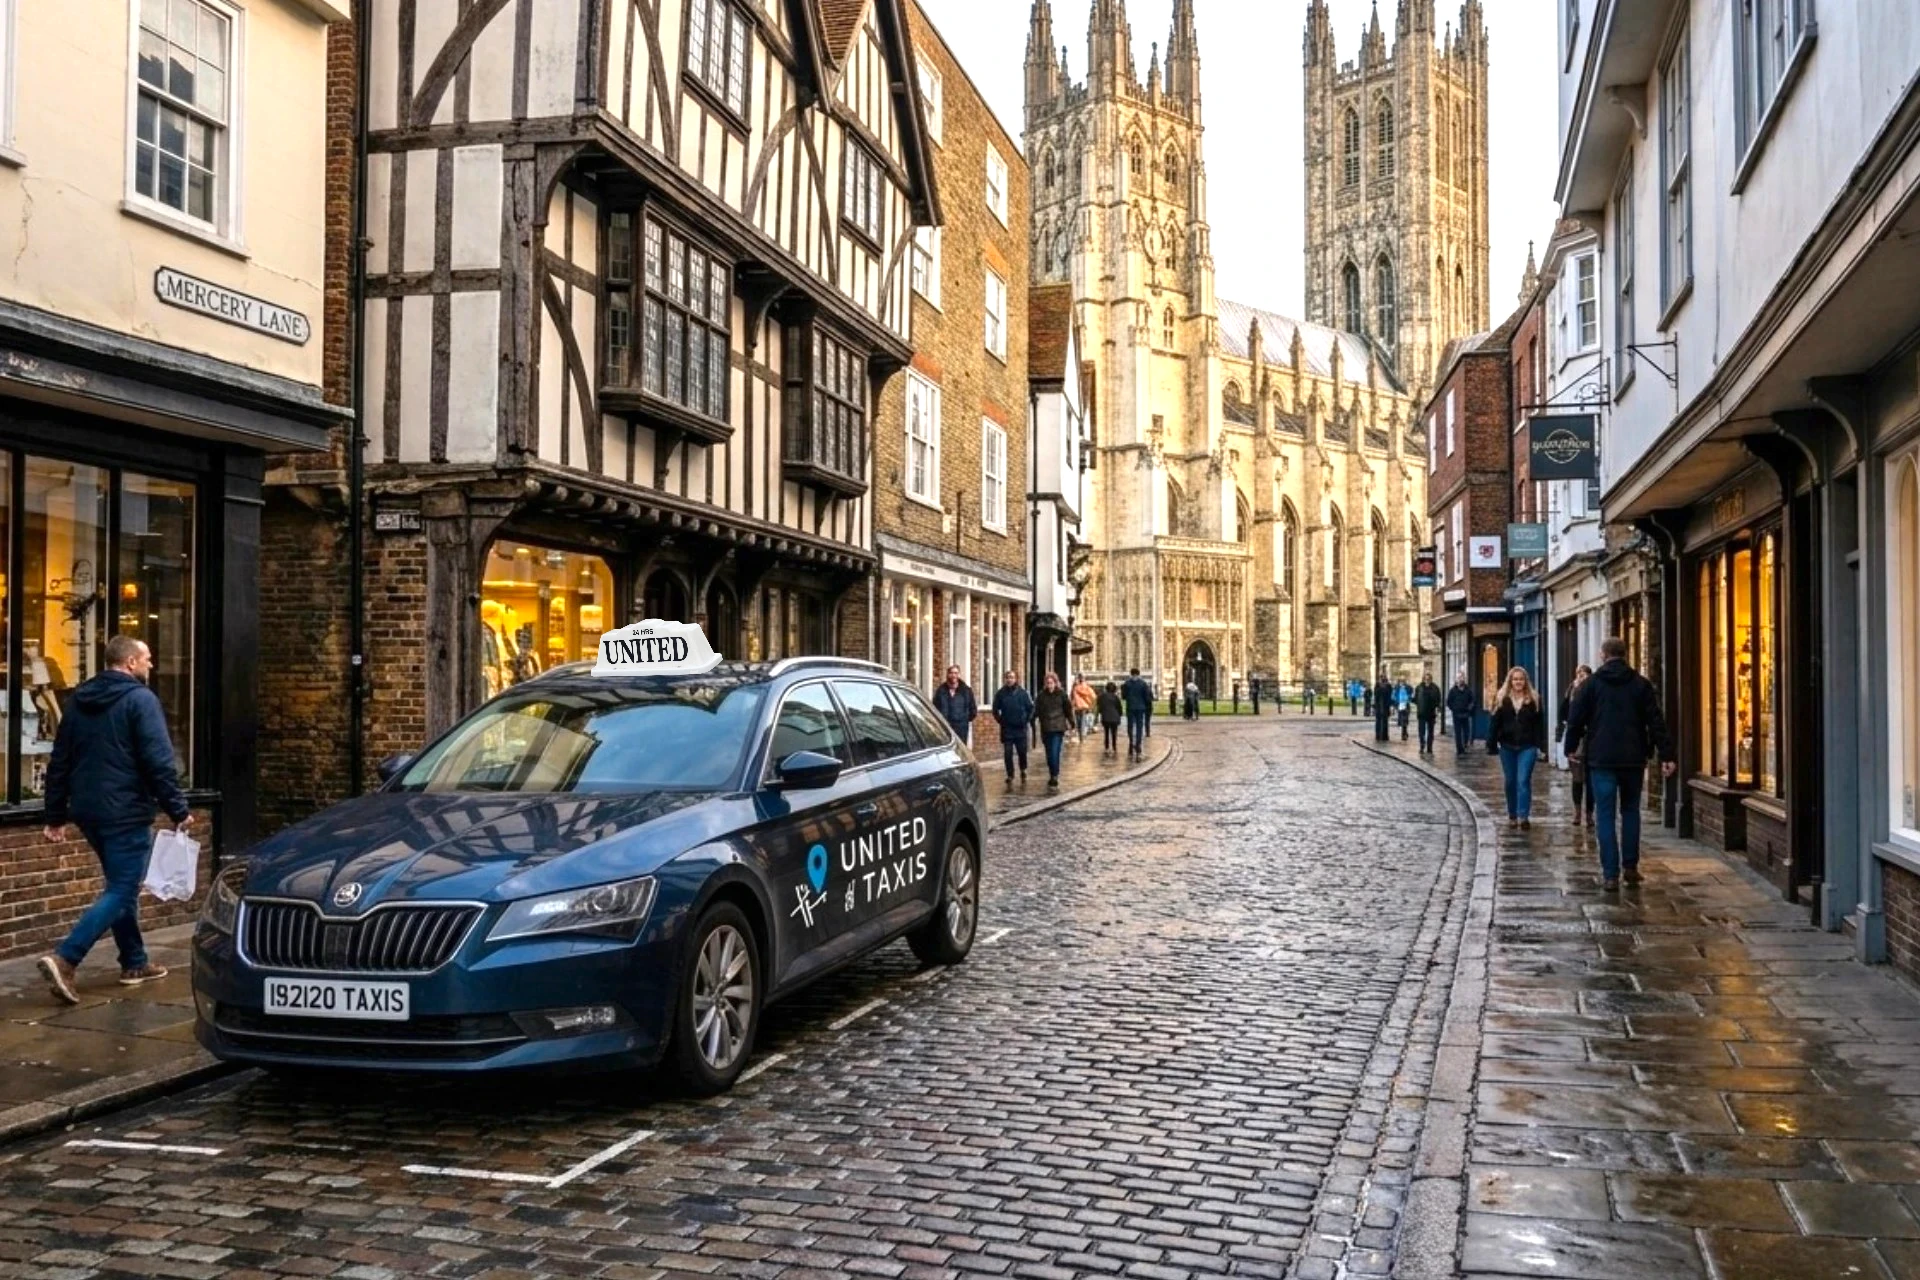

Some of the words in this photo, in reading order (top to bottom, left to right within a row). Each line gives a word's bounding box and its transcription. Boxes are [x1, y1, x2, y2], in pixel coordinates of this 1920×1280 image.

[167, 275, 252, 321] MERCERY
[259, 306, 302, 337] LANE
[603, 636, 689, 665] UNITED
[640, 628, 654, 636] HRS
[840, 817, 927, 871] UNITED
[862, 851, 927, 902] TAXIS
[342, 988, 404, 1012] TAXIS
